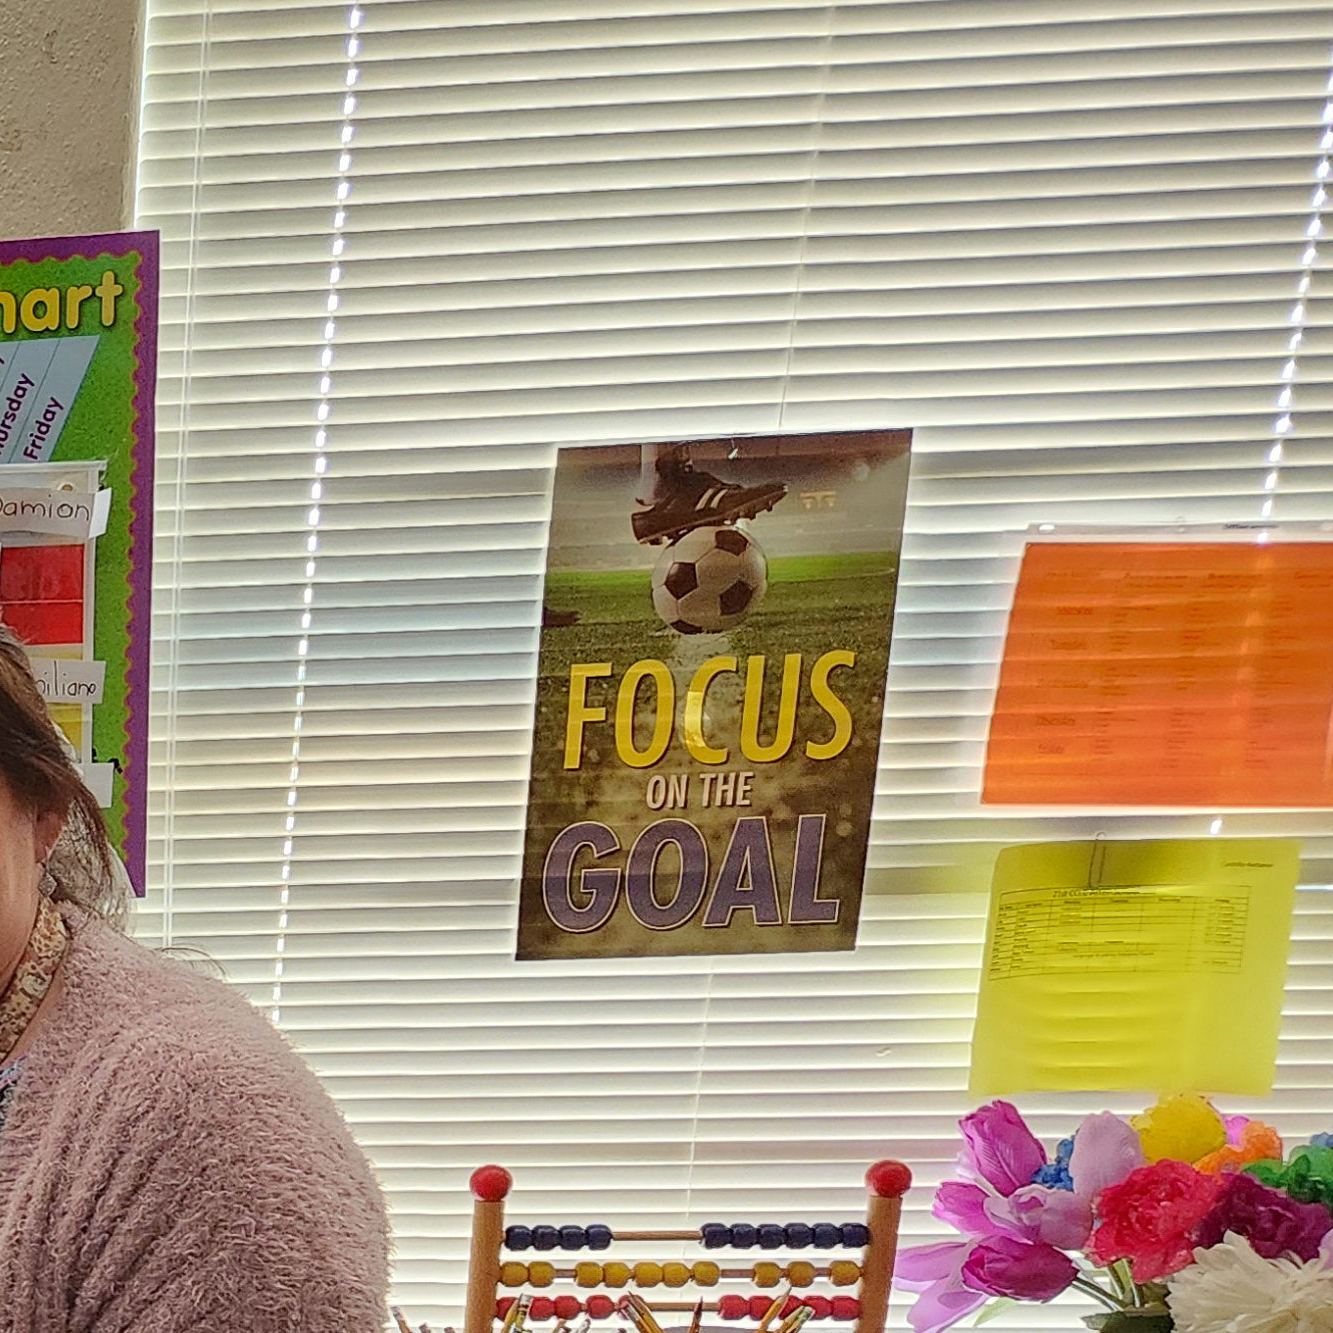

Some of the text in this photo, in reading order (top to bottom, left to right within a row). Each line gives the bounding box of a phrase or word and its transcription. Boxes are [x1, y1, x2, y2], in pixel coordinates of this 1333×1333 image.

[22, 396, 65, 461] Friday
[562, 649, 858, 770] FOCUS
[645, 770, 754, 809] ON THE
[541, 812, 842, 934] GOAL
